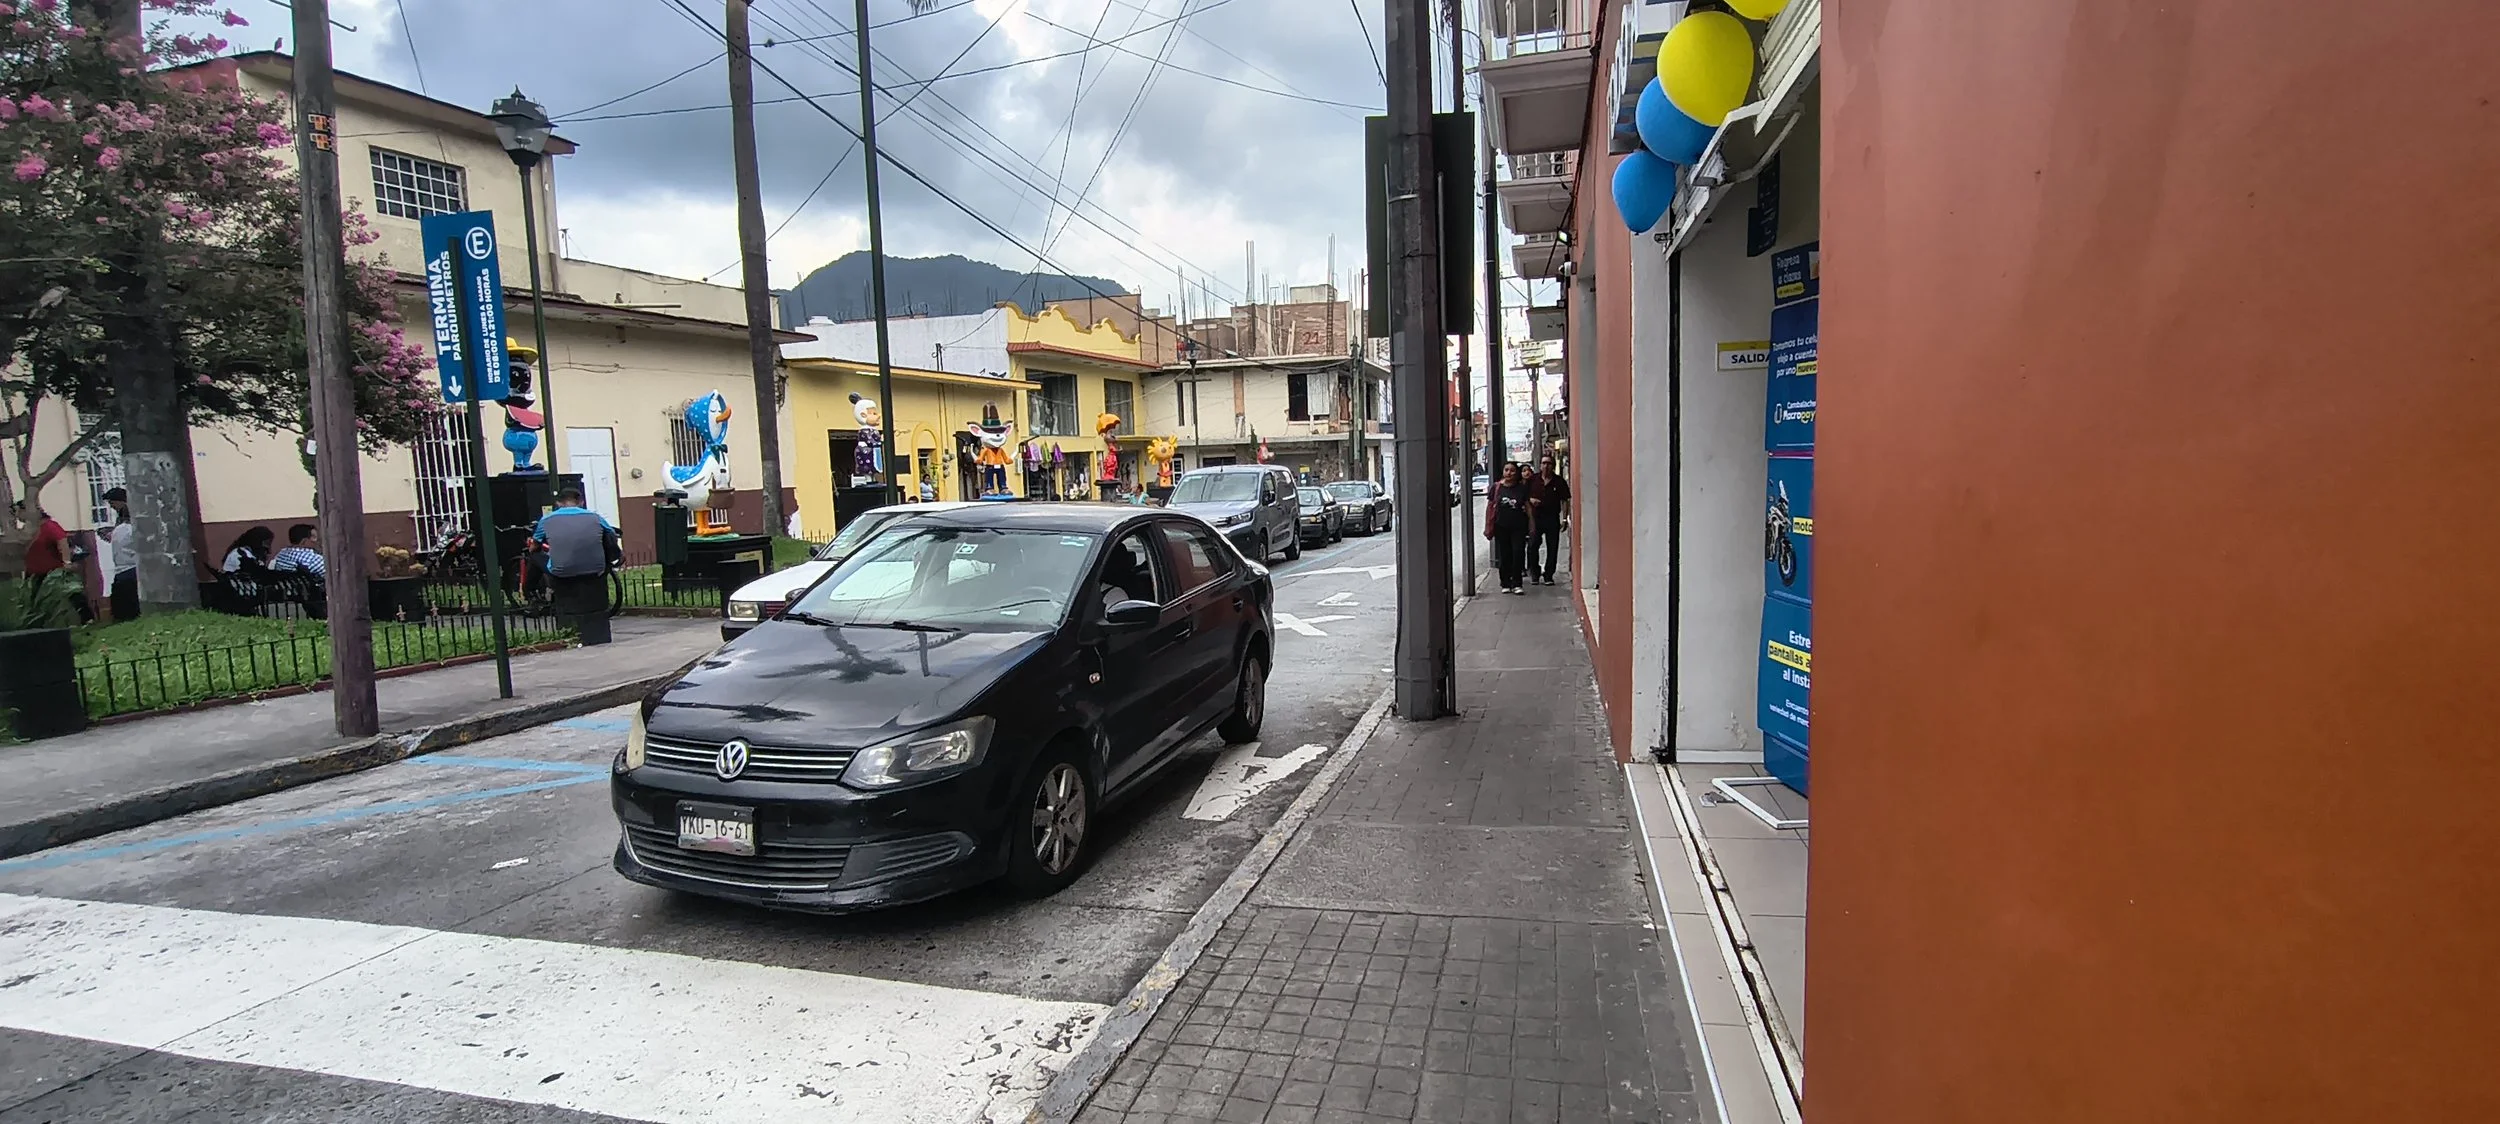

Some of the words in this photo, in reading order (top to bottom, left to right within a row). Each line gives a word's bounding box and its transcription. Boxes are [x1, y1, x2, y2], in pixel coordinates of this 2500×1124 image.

[481, 268, 493, 303] HORAS
[428, 258, 451, 355] TERMINA
[441, 250, 462, 361] PARQUIMETROS
[479, 313, 488, 337] LUNES
[486, 303, 496, 331] 21:00
[483, 338, 490, 349] DE
[489, 331, 497, 339] A
[1302, 331, 1320, 345] 21
[1805, 334, 1817, 344] cel
[490, 339, 500, 369] 08:00
[484, 349, 494, 383] HORARIO
[493, 369, 501, 383] DE
[1783, 410, 1816, 423] Macropay
[1769, 645, 1803, 666] pantallas
[1783, 668, 1790, 681] al
